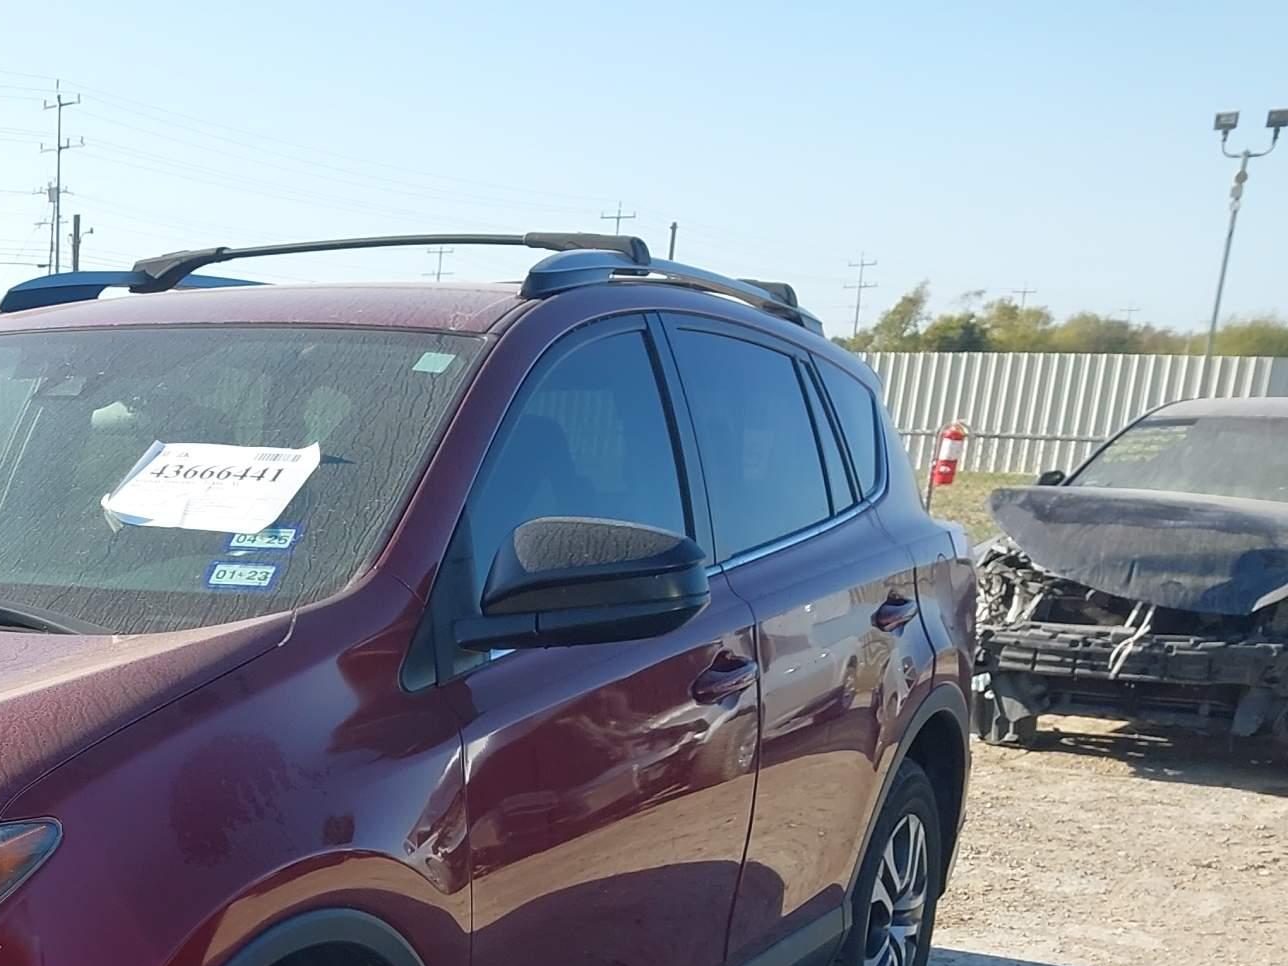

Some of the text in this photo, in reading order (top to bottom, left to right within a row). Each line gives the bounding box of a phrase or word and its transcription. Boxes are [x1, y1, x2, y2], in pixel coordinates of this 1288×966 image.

[150, 463, 285, 483] 43666441
[236, 534, 257, 544] 04
[215, 569, 270, 581] 01 23
